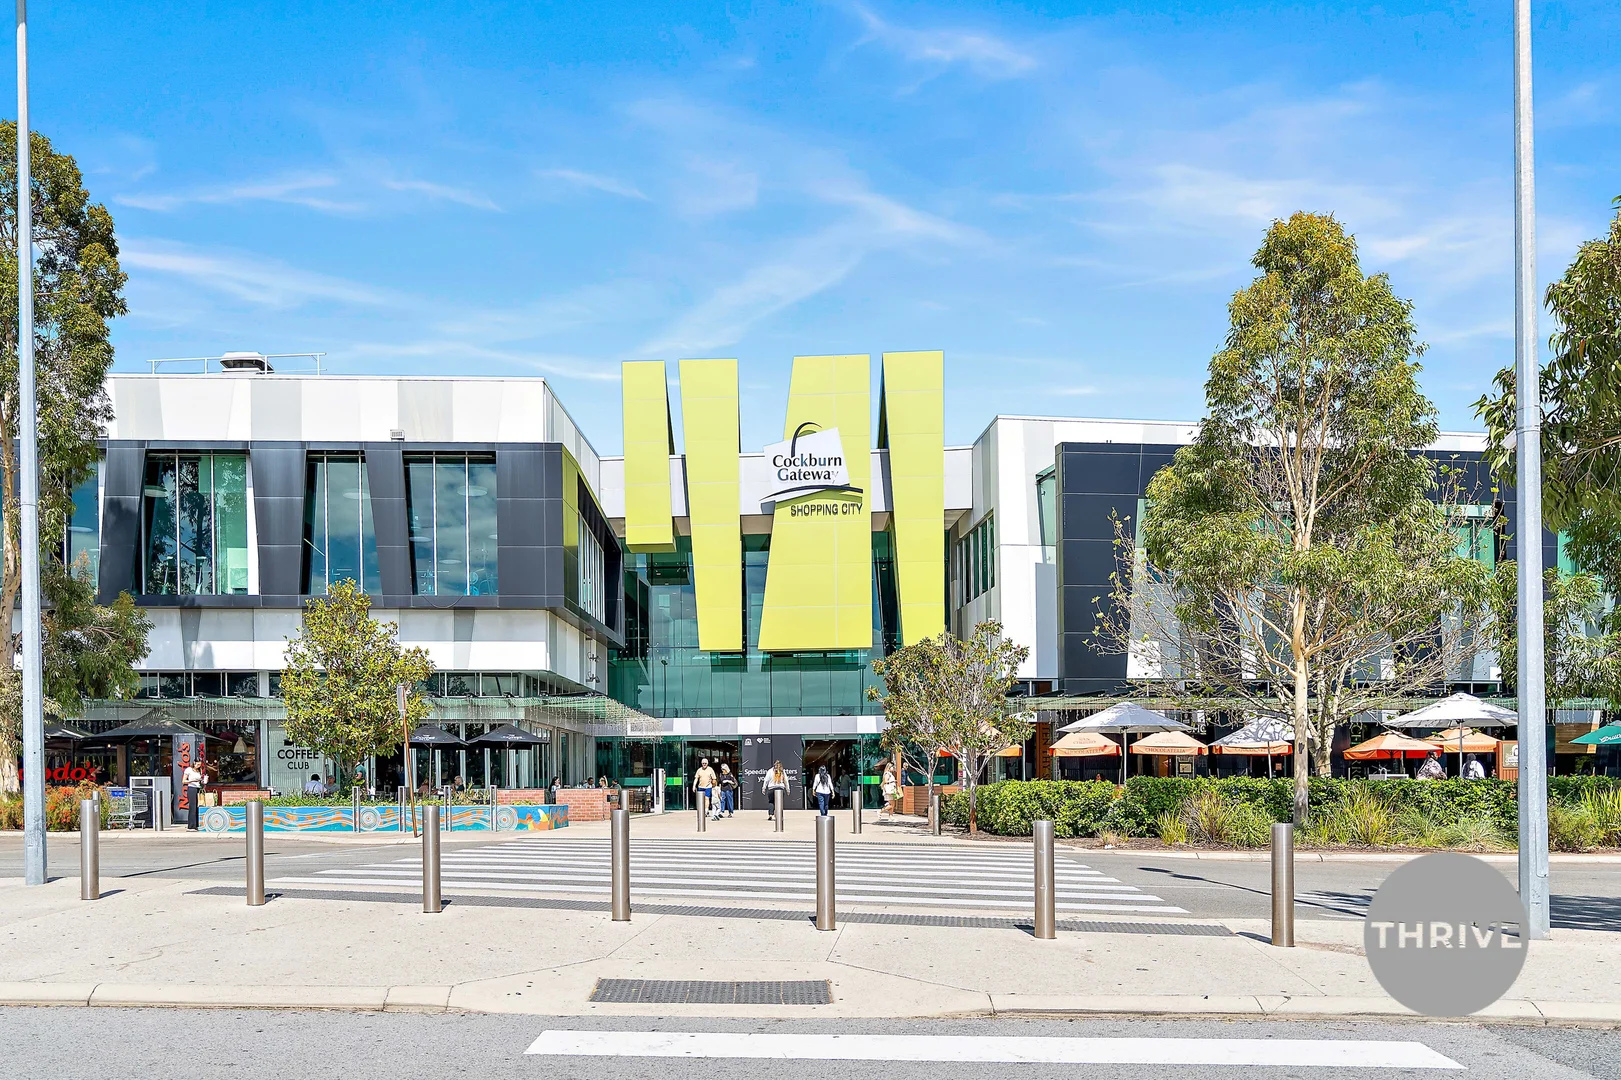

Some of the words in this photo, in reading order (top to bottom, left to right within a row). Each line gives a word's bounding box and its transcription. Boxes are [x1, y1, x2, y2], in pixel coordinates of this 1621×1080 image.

[772, 453, 842, 468] Cockburn
[777, 468, 839, 484] Gateway
[790, 503, 839, 517] SHOPPING
[841, 502, 863, 515] CITY
[277, 749, 319, 760] COFFEE
[287, 761, 310, 770] CLUB
[744, 768, 769, 776] Speedin
